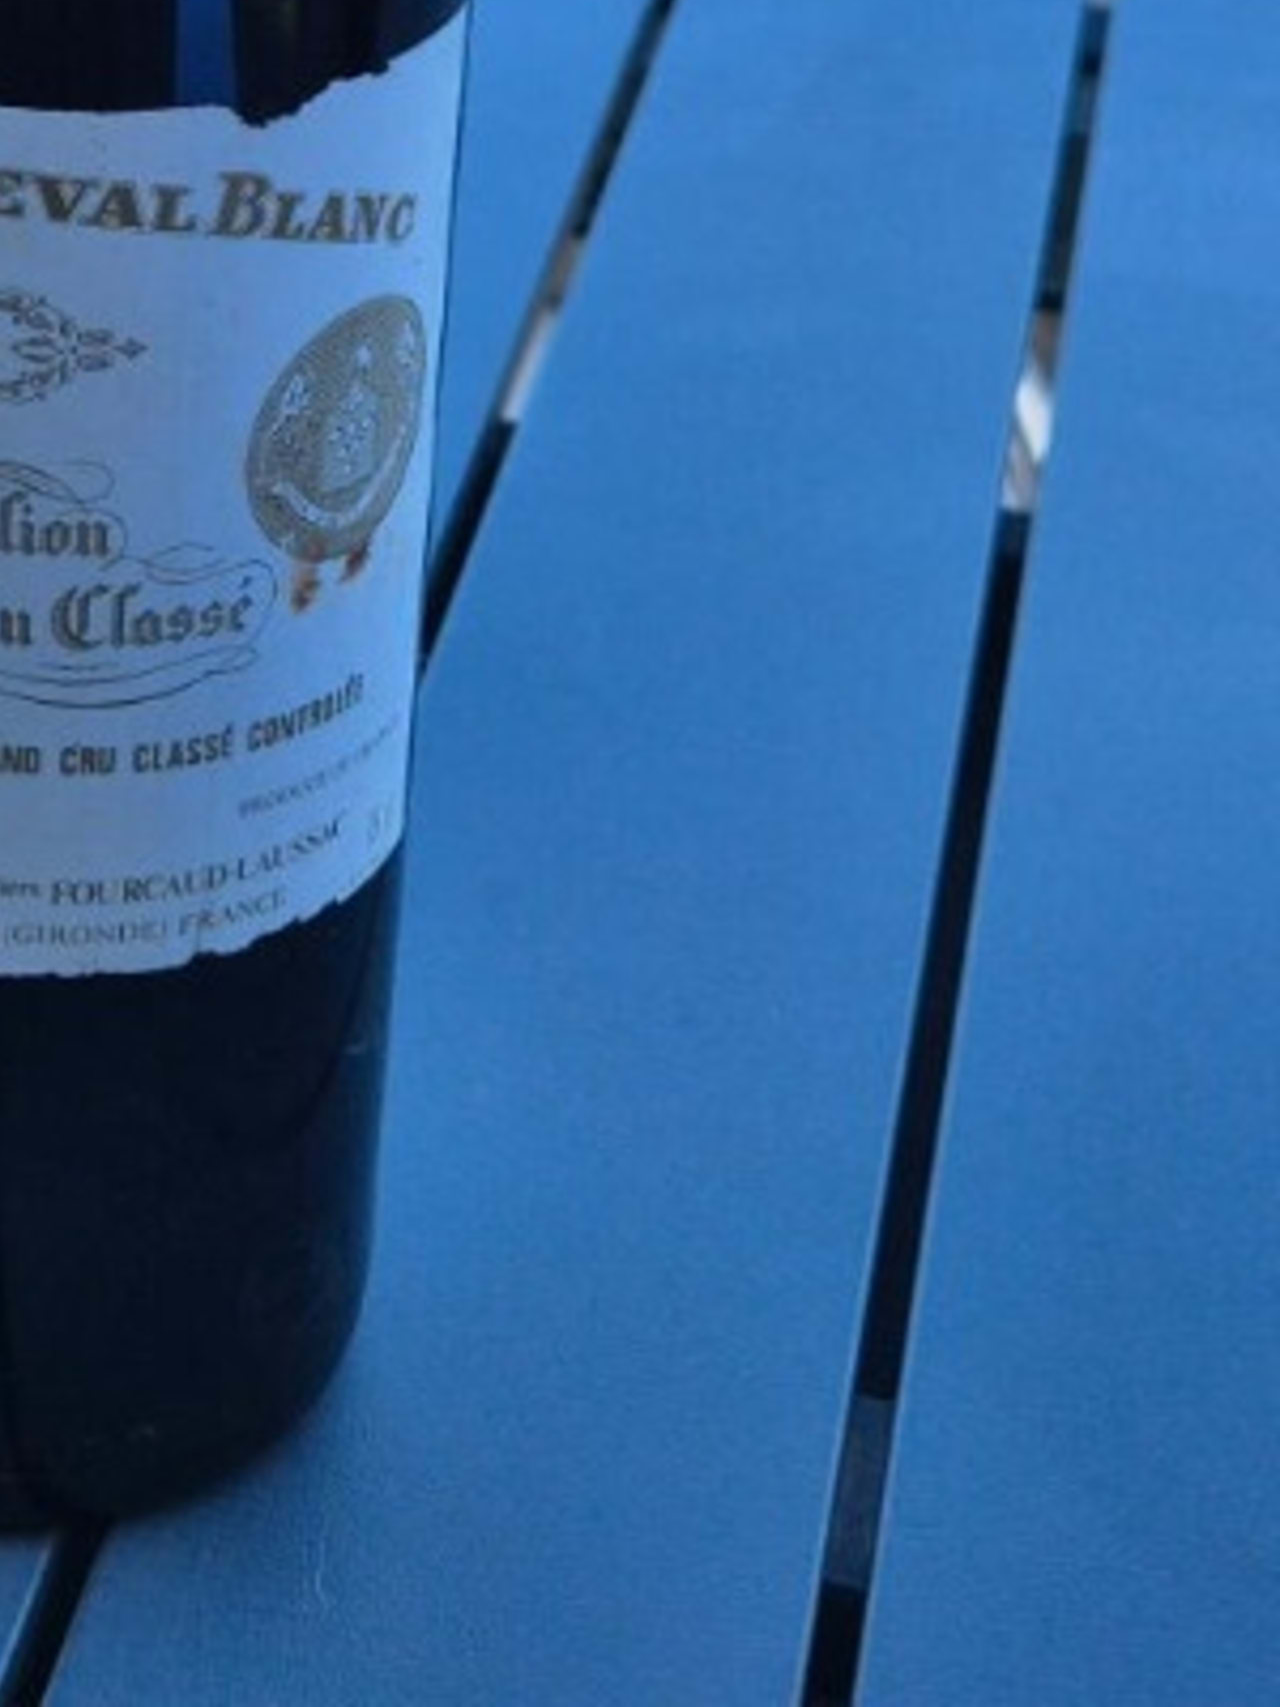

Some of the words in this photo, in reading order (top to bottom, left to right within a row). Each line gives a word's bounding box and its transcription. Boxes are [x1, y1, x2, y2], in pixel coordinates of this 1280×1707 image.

[207, 170, 420, 245] BLANC
[51, 574, 253, 650] Classé
[59, 743, 117, 777] CRU
[132, 722, 234, 774] CLASSÉ
